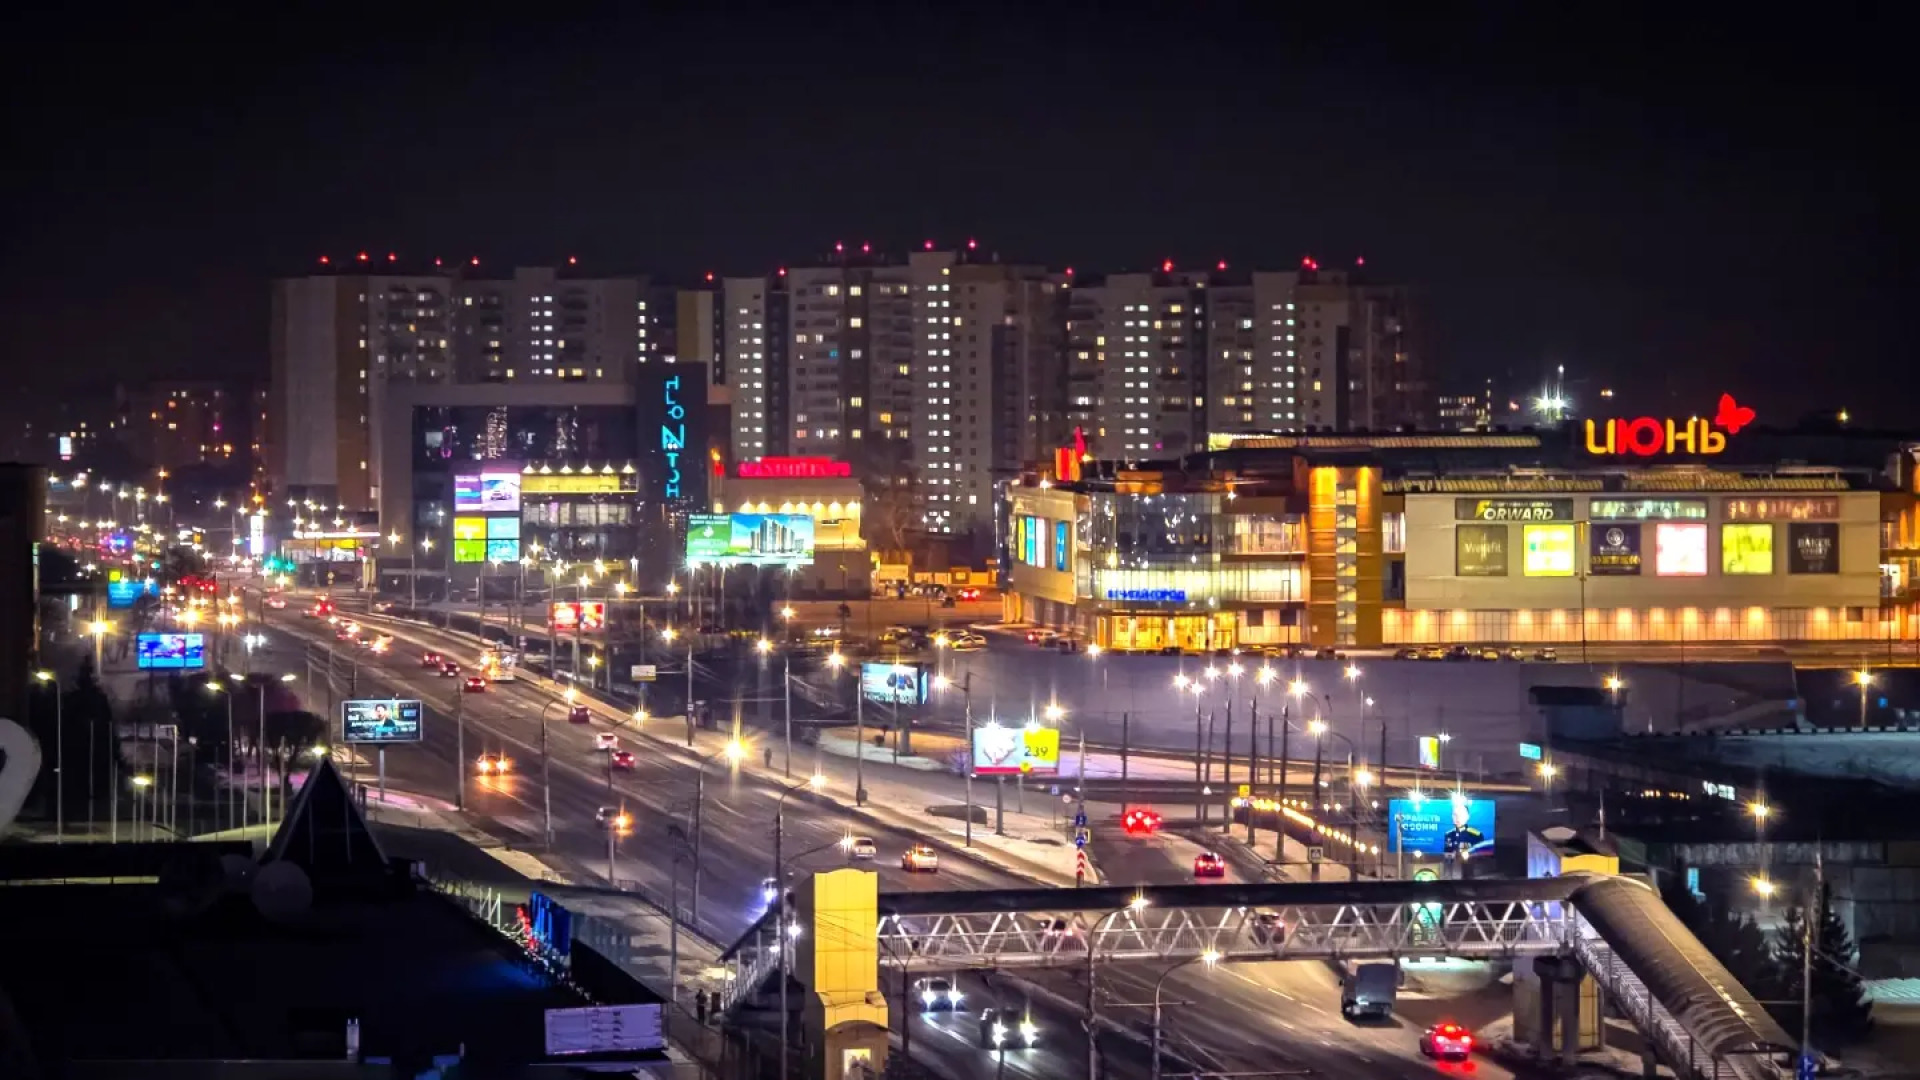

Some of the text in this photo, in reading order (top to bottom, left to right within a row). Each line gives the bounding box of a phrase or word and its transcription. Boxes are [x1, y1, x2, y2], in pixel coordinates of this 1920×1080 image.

[1585, 416, 1726, 456] ИЮНЬ
[1475, 500, 1554, 520] FORWARD
[1024, 745, 1049, 757] 239
